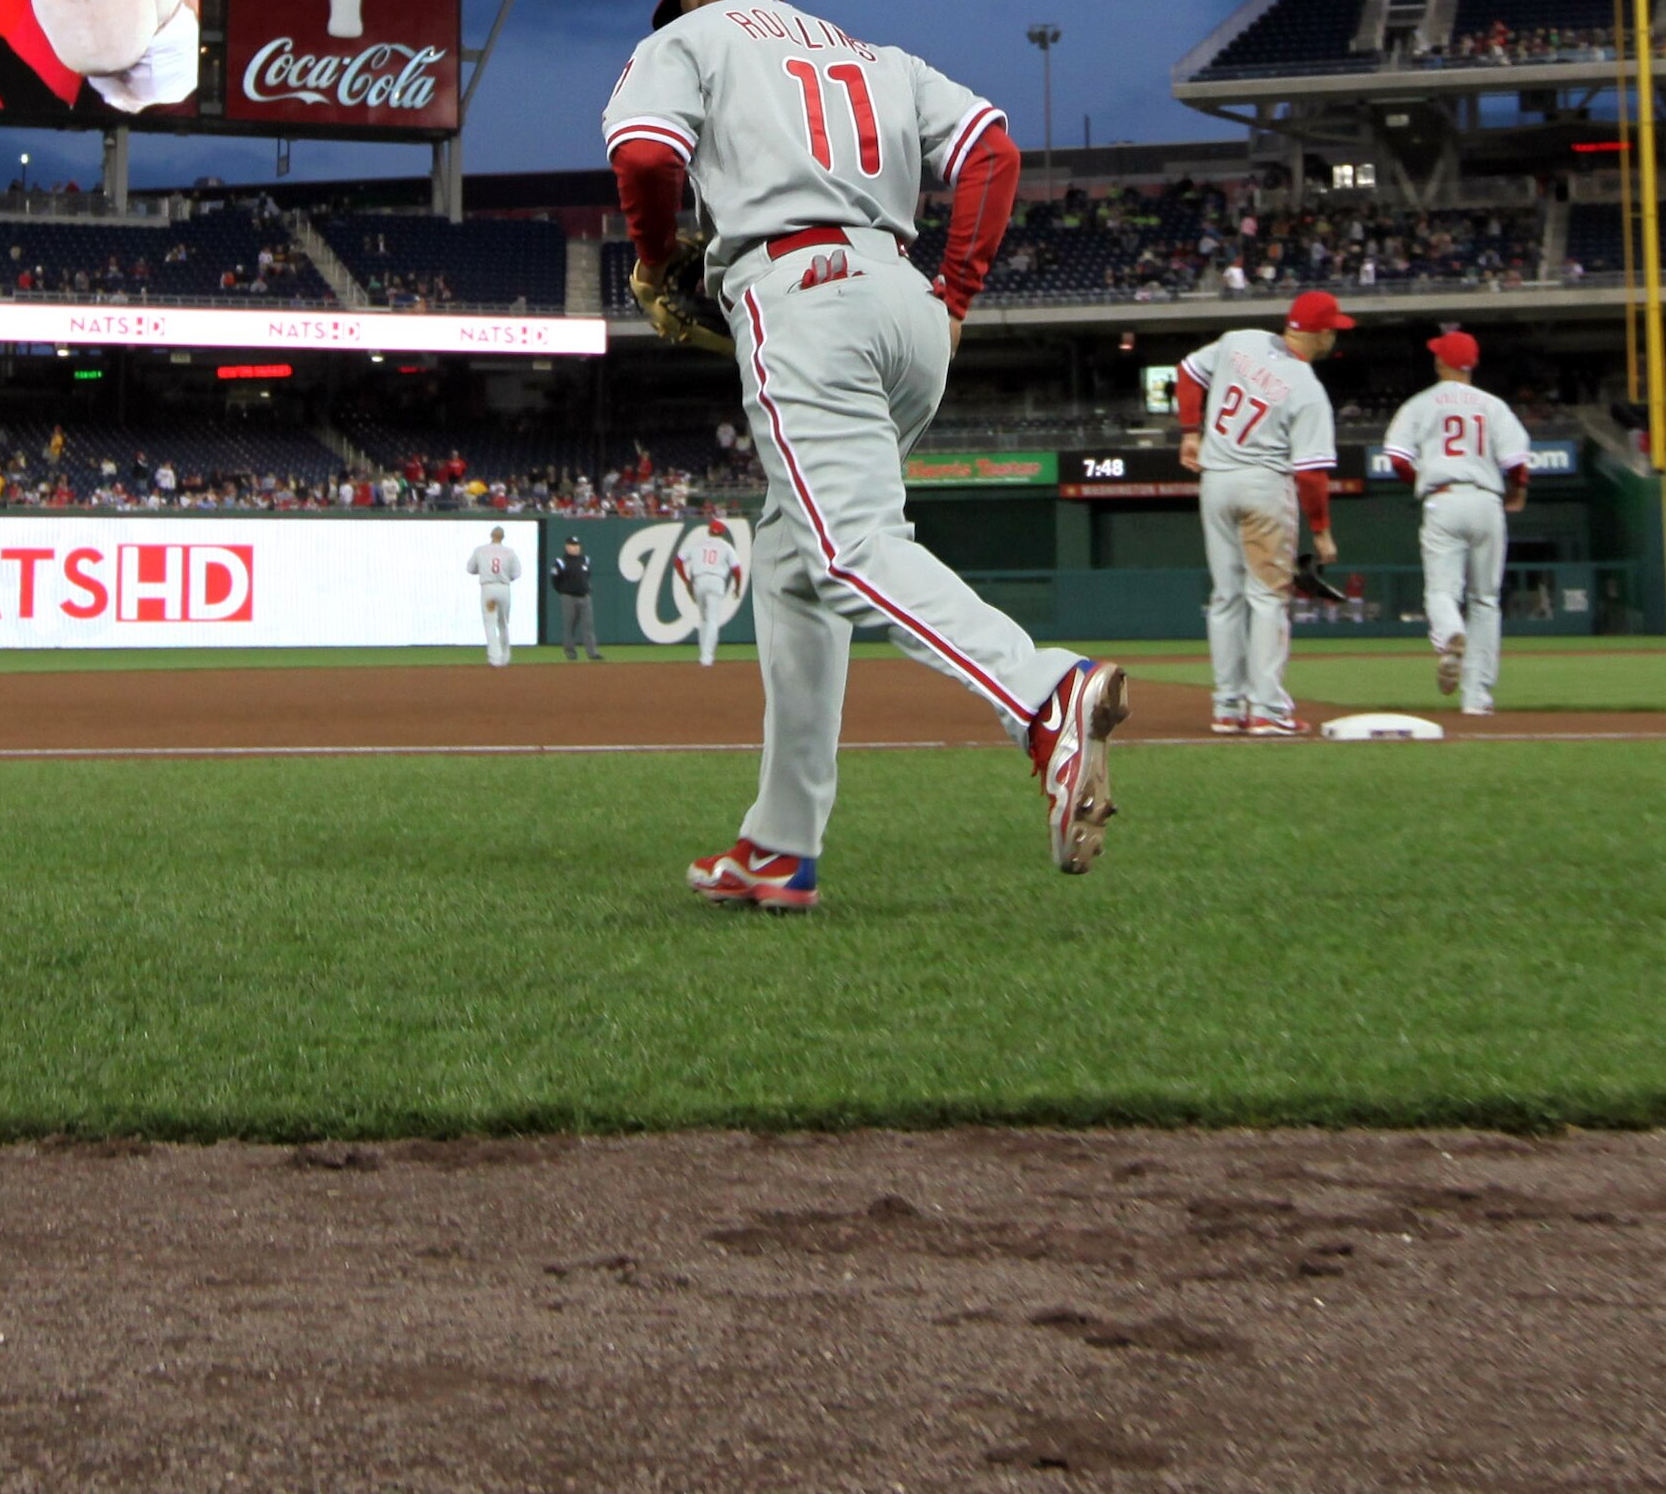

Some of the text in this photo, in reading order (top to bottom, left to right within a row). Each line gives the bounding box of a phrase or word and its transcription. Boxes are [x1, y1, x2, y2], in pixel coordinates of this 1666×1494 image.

[242, 36, 448, 109] Coca-Cola
[783, 58, 883, 179] 11
[1214, 383, 1271, 447] 27
[1443, 414, 1488, 459] 21
[1083, 459, 1125, 478] 7:48
[490, 557, 500, 575] 8
[702, 548, 718, 566] 10
